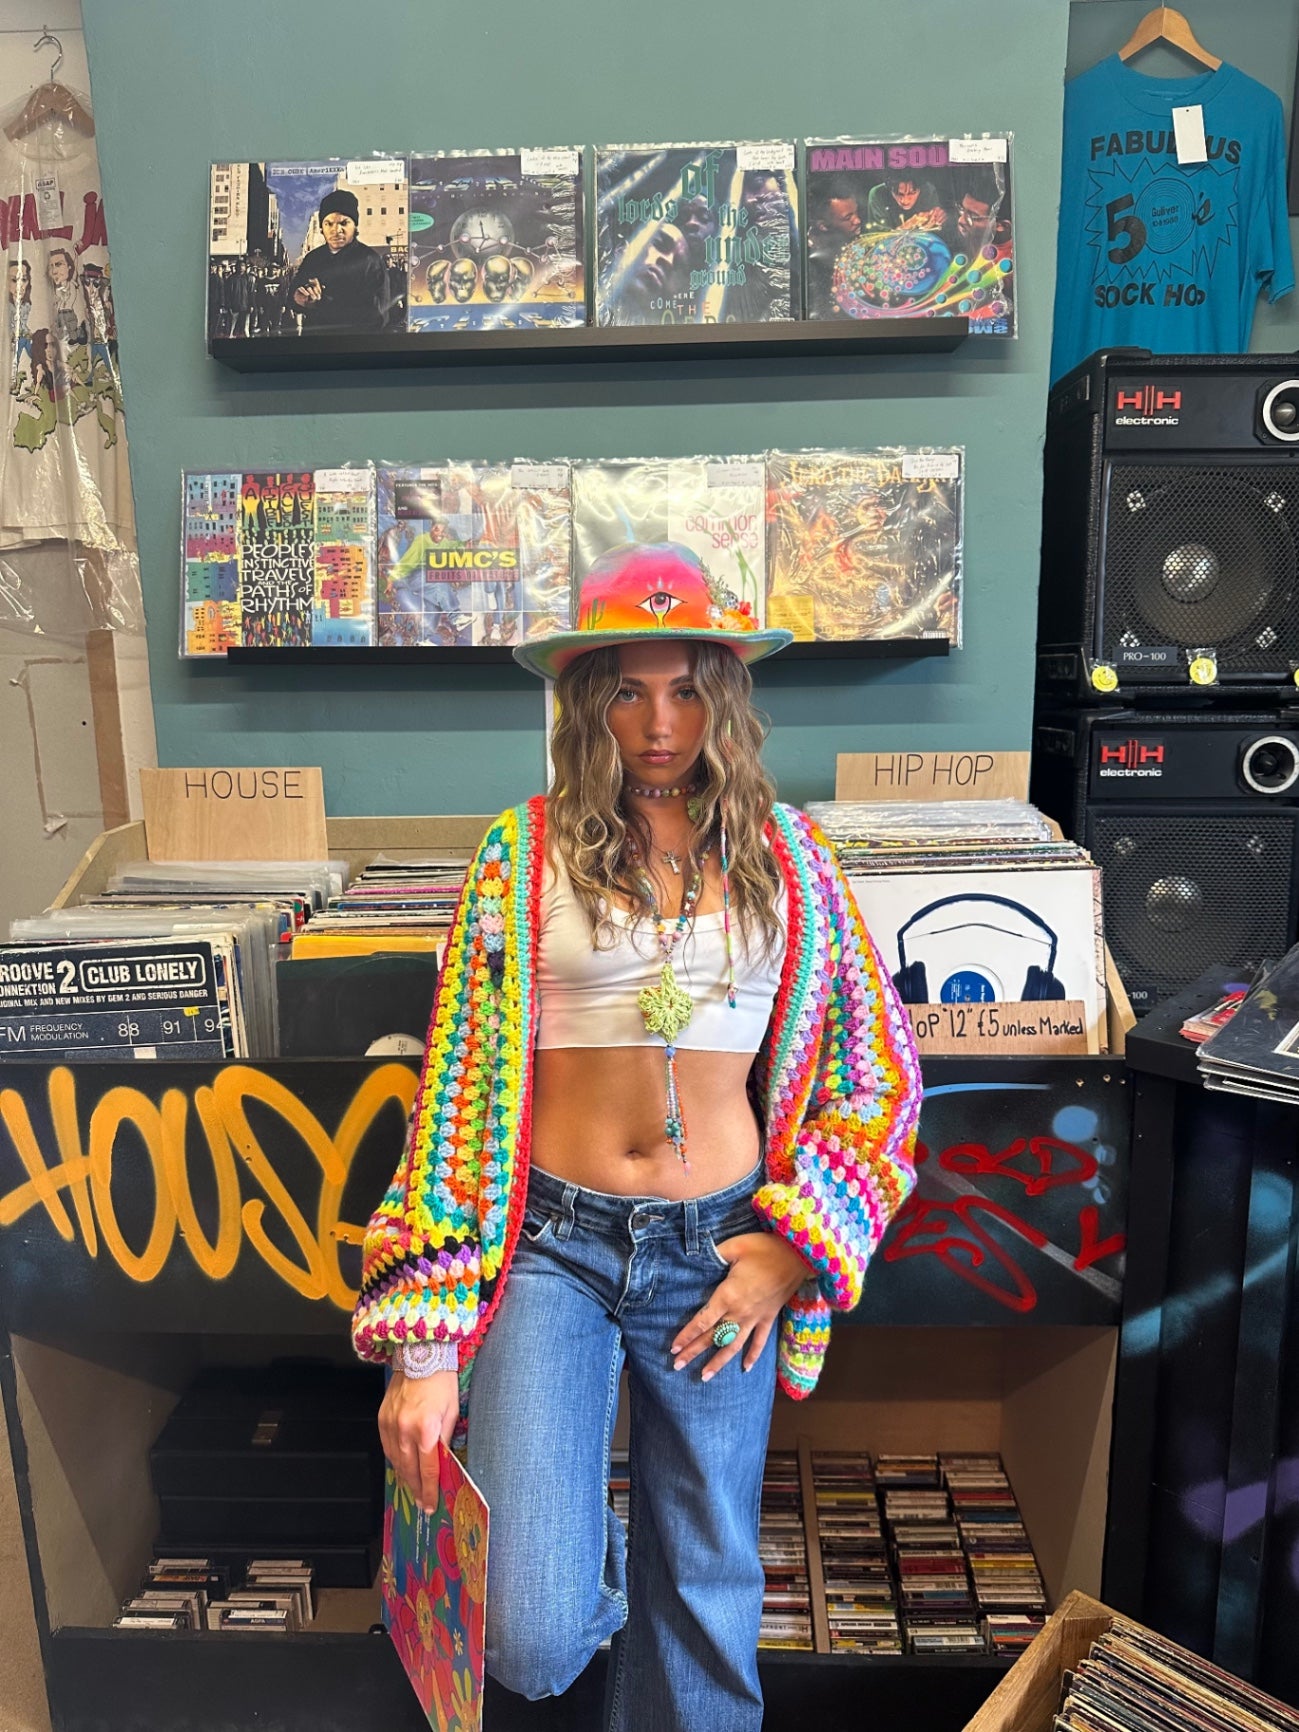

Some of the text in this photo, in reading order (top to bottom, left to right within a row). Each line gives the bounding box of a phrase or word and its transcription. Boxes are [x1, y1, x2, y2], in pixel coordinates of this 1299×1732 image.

[1090, 130, 1242, 165] FABULUS
[811, 149, 884, 171] MAIN
[1094, 282, 1157, 308] SOCK
[1115, 416, 1179, 426] electronic
[429, 551, 517, 569] UMC'S
[240, 568, 314, 584] TRAVELS
[429, 570, 463, 581] FRUITS
[241, 582, 299, 598] PATHS
[241, 596, 314, 614] RHYTHM
[1123, 652, 1167, 661] PRO-100
[875, 754, 994, 786] HIP HOP
[1100, 768, 1163, 778] electronic
[185, 770, 304, 799] HOUSE
[0, 962, 55, 983] ROOVE
[56, 960, 79, 994] 2
[87, 961, 199, 986] CLUB LONELY
[0, 982, 57, 997] ONNEKTION
[73, 995, 95, 1004] MIXES
[96, 995, 106, 1003] BY
[125, 994, 131, 1002] 2
[132, 992, 147, 1001] AND
[148, 990, 177, 1000] SERIOUS
[30, 1022, 83, 1033] FREQUENCY
[118, 1022, 140, 1038] 88
[162, 1020, 181, 1035] 91
[978, 1008, 999, 1038] £5
[1003, 1019, 1037, 1038] unless
[1039, 1016, 1083, 1036] Marked
[31, 1031, 89, 1041] MODULATION
[0, 1064, 419, 1311] HOUSE
